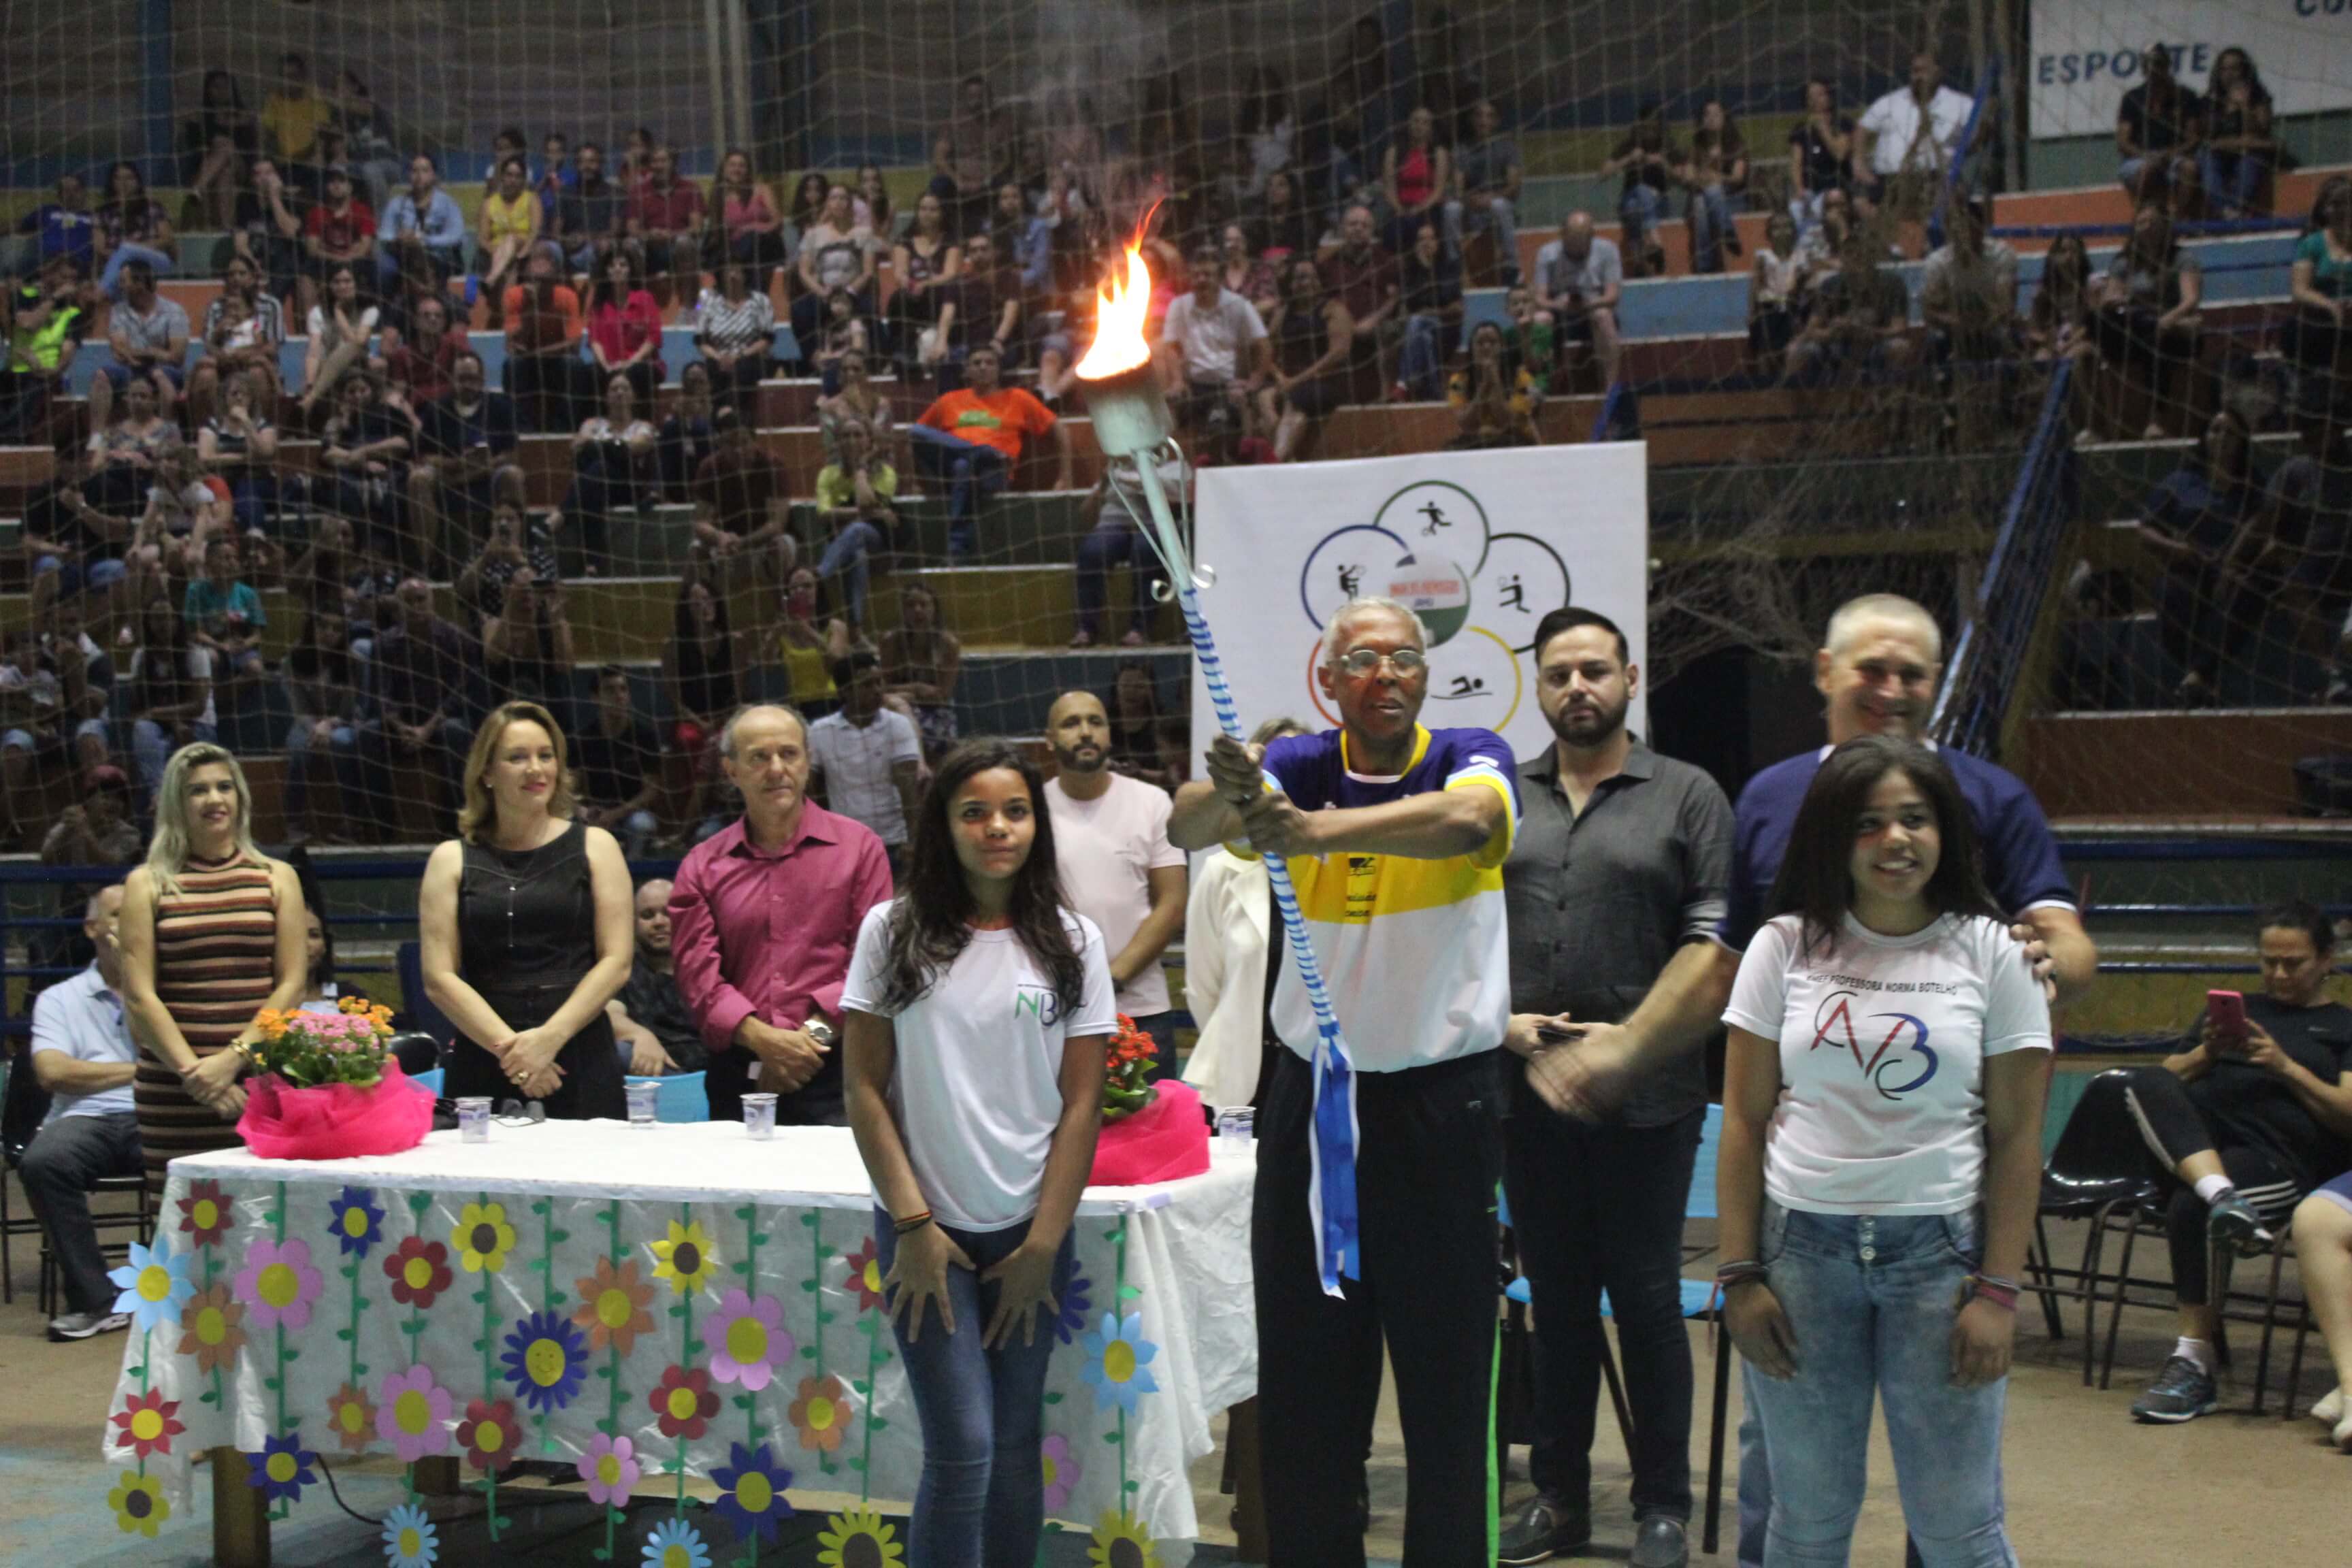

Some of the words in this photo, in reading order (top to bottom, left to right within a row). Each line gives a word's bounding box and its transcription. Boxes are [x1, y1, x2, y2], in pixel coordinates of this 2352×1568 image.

[2037, 43, 2210, 84] ESPOTE
[1831, 975, 1883, 992] PROFESSORA
[1885, 982, 1916, 992] NORMA
[1918, 982, 1958, 996] BOTELHO
